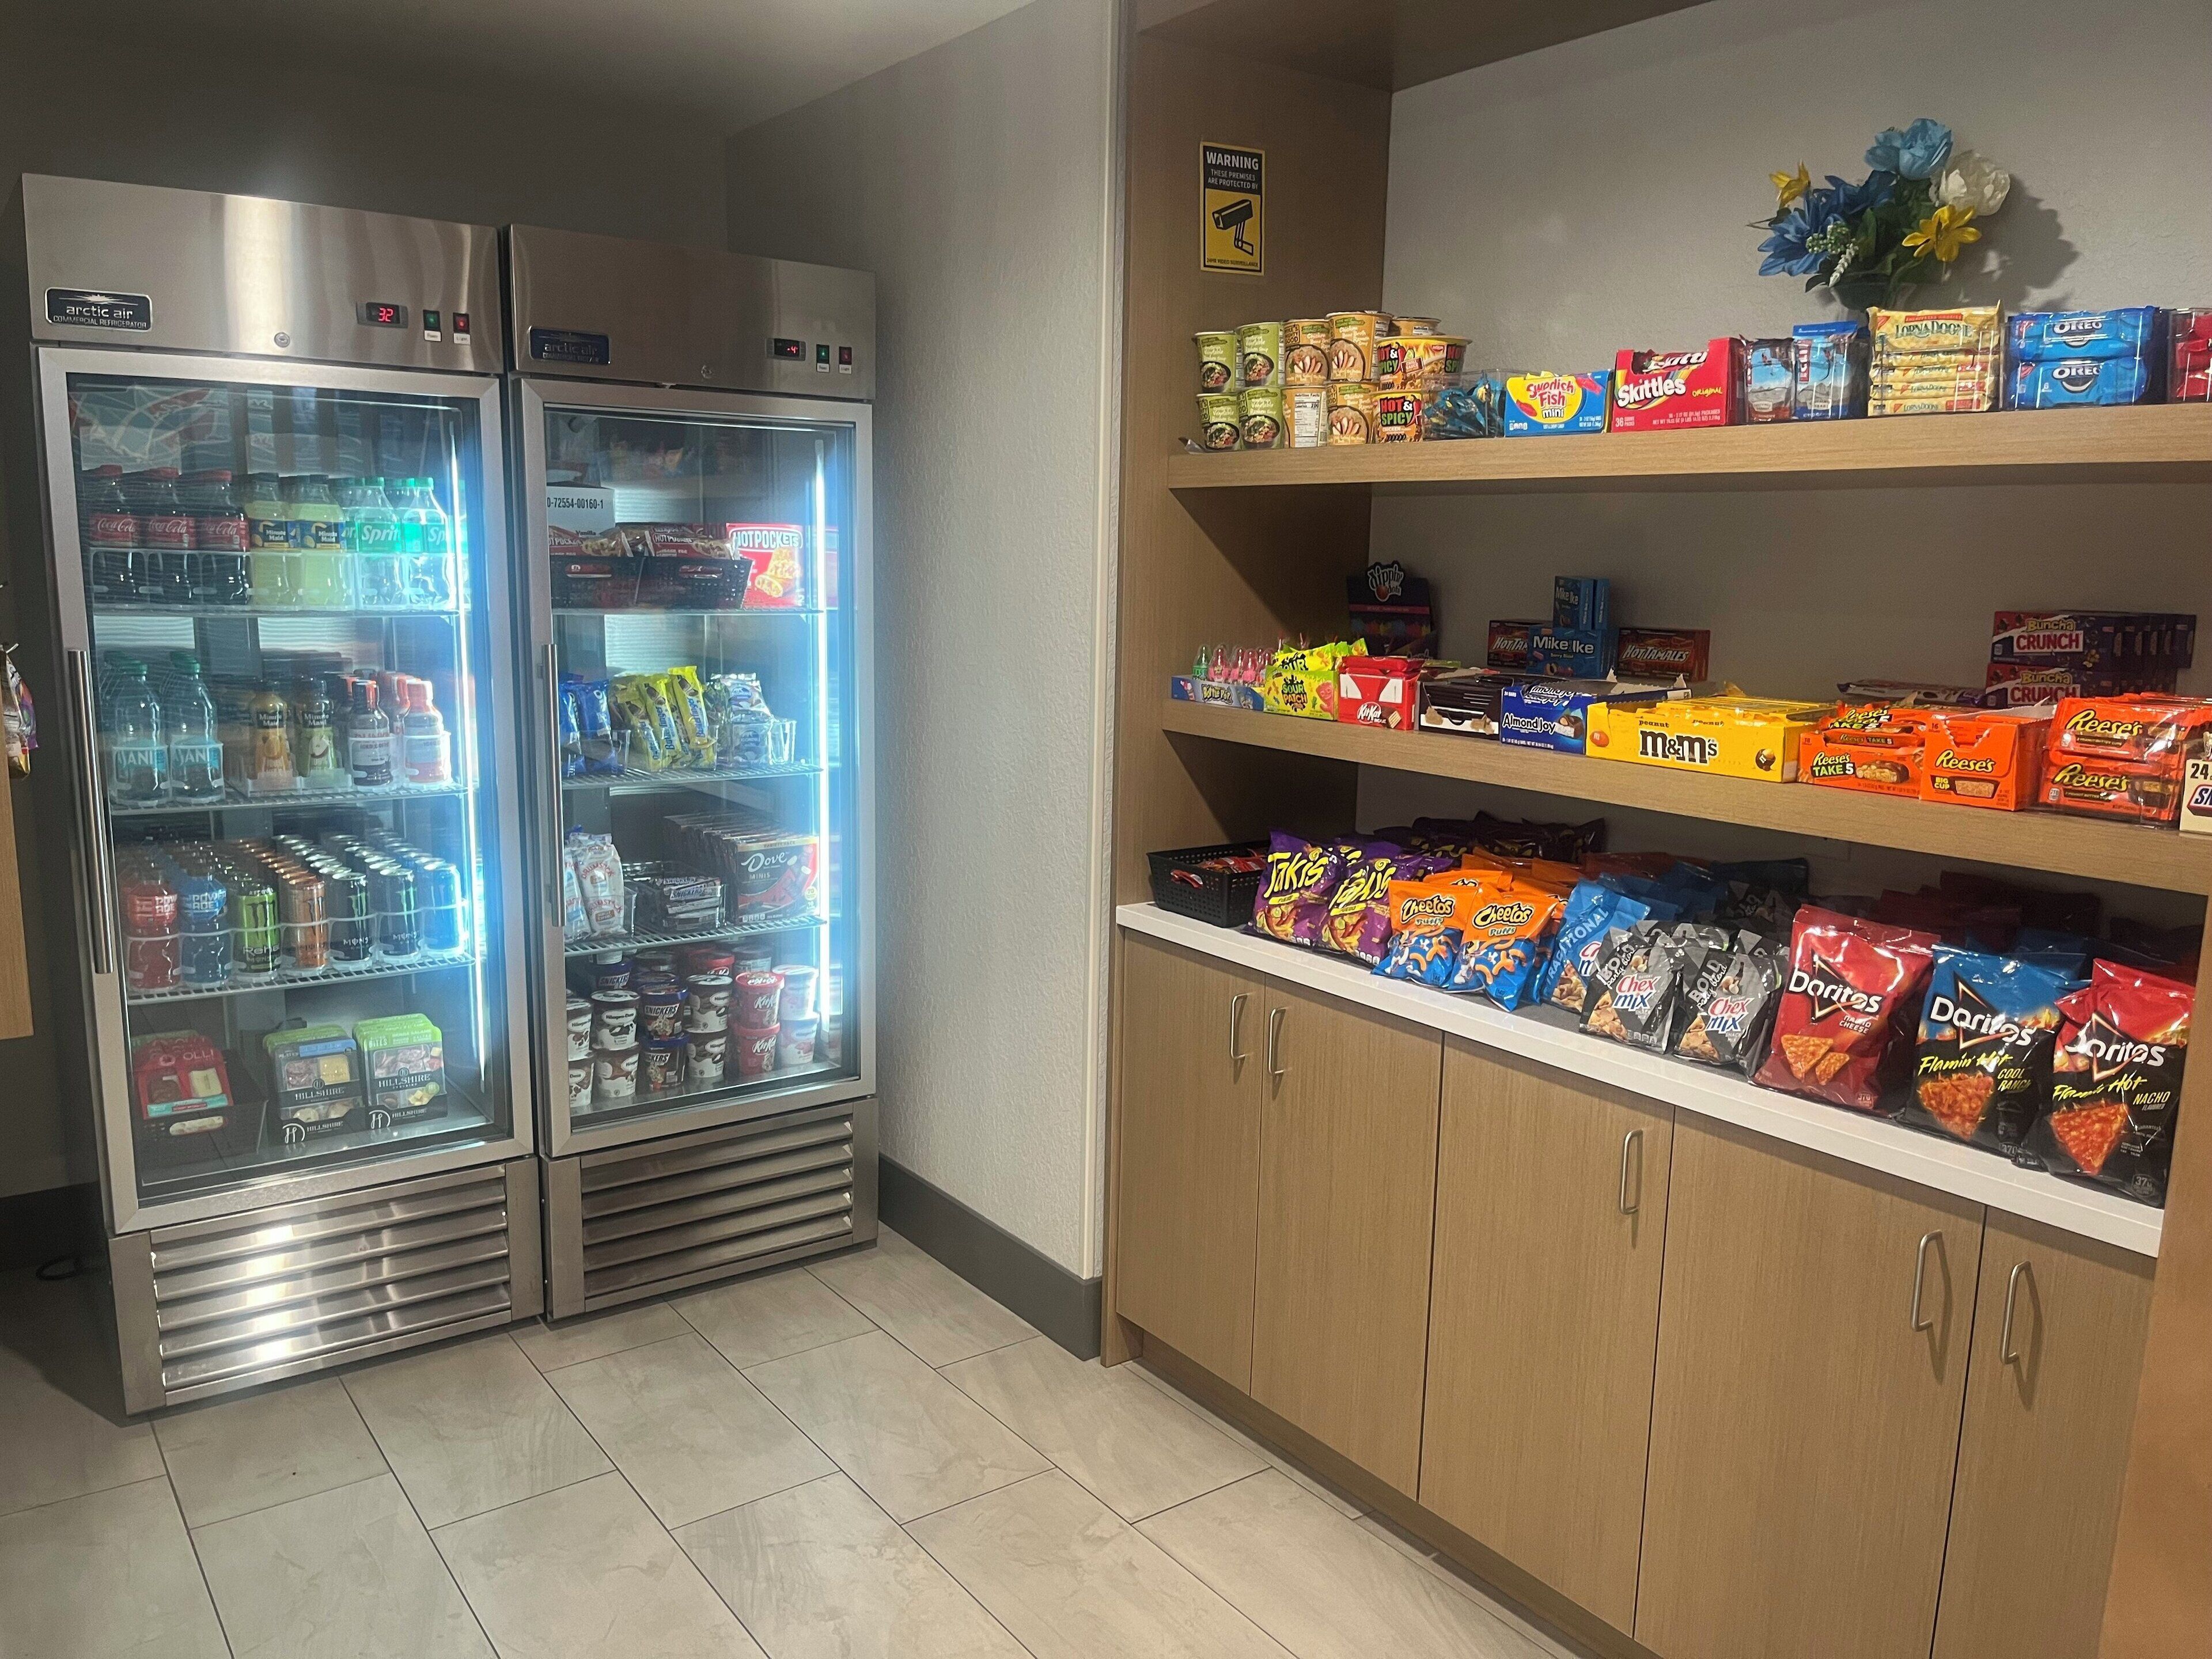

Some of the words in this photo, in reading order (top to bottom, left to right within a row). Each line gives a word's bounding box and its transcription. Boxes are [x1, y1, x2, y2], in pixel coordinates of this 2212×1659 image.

[1206, 151, 1259, 171] WARNING
[1211, 169, 1228, 179] THESE
[1229, 172, 1256, 181] PREMISES
[1208, 177, 1218, 185] ARE
[1219, 179, 1250, 189] PROTECTED
[66, 306, 109, 317] arctic
[113, 308, 132, 319] air
[378, 307, 393, 323] 32
[54, 315, 98, 325] COMMERCIAL
[100, 319, 147, 329] REFRIGERATOR
[2054, 321, 2102, 334] OREO
[1895, 323, 1929, 339] LORNA
[1931, 321, 1972, 338] DOONE
[1390, 349, 1398, 358] &
[2052, 366, 2101, 380] OREO
[1527, 378, 1574, 398] Swedish
[1617, 376, 1686, 407] Skittles
[1692, 387, 1723, 397] ORIGINAL
[1381, 398, 1404, 412] HOT
[1403, 401, 1413, 411] &
[1539, 392, 1566, 407] Fish
[1382, 412, 1413, 426] SPICY
[1542, 408, 1564, 419] mini
[1615, 418, 1624, 427] 36
[547, 497, 604, 510] 0-72554-00160-1
[362, 525, 401, 544] Sprit
[655, 535, 668, 543] HOT
[733, 531, 753, 549] HOT
[754, 531, 800, 549] POCKETS
[2027, 619, 2075, 632] Buncha
[1493, 636, 1512, 650] HOT
[1533, 635, 1569, 651] Mike
[1572, 639, 1594, 654] Ike
[2016, 634, 2080, 650] CRUNCH
[1622, 645, 1646, 661] HOT
[1643, 646, 1691, 662] TAMALES
[2021, 672, 2072, 684] Buncha
[1282, 684, 1304, 694] SOUR
[2010, 687, 2080, 703] CRUNCH
[1283, 693, 1308, 704] PATCH
[1502, 713, 1538, 729] Almond
[1538, 717, 1555, 735] Joy
[1639, 719, 1669, 728] peanut
[2067, 709, 2143, 737] Reese's
[118, 750, 153, 768] ASANI
[1813, 751, 1851, 766] Reese's
[1935, 749, 1994, 773] Reese's
[1813, 764, 1843, 777] TAKE
[1845, 763, 1854, 775] 5
[2190, 763, 2208, 779] 24
[2054, 764, 2130, 792] Reese's
[741, 852, 787, 872] Dove
[156, 895, 177, 905] POW
[1402, 895, 1455, 923] Cheetos
[1474, 903, 1534, 927] Cheetos
[1488, 927, 1516, 936] Puffs
[243, 945, 279, 957] Reha
[1600, 944, 1635, 980] BOLD
[1607, 968, 1626, 989] party
[1618, 975, 1656, 993] Chex
[1688, 960, 1722, 1002] BOLD
[1697, 985, 1718, 1011] party
[1711, 964, 1728, 986] blend
[1789, 969, 1883, 1013] Doritos
[1614, 992, 1652, 1009] mix
[1709, 997, 1749, 1016] Chex
[645, 1003, 679, 1016] SNICKERS
[1707, 1016, 1743, 1032] mix
[1839, 1021, 1870, 1034] CHEESE
[1930, 996, 2037, 1046] Doritos
[753, 1036, 777, 1053] KitKa
[645, 1053, 670, 1063] ICKERS
[1918, 1052, 1976, 1077] Flamin'
[378, 1074, 431, 1088] HILLSHIRE
[1998, 1069, 2025, 1080] COOL
[1998, 1079, 2031, 1092] RANCH
[2108, 1073, 2147, 1093] Hot
[294, 1087, 344, 1101] HILLSHIRE
[2133, 1091, 2171, 1105] NACHO
[392, 1108, 427, 1118] HILLSHIRE
[306, 1120, 344, 1132] HILLSHIRE
